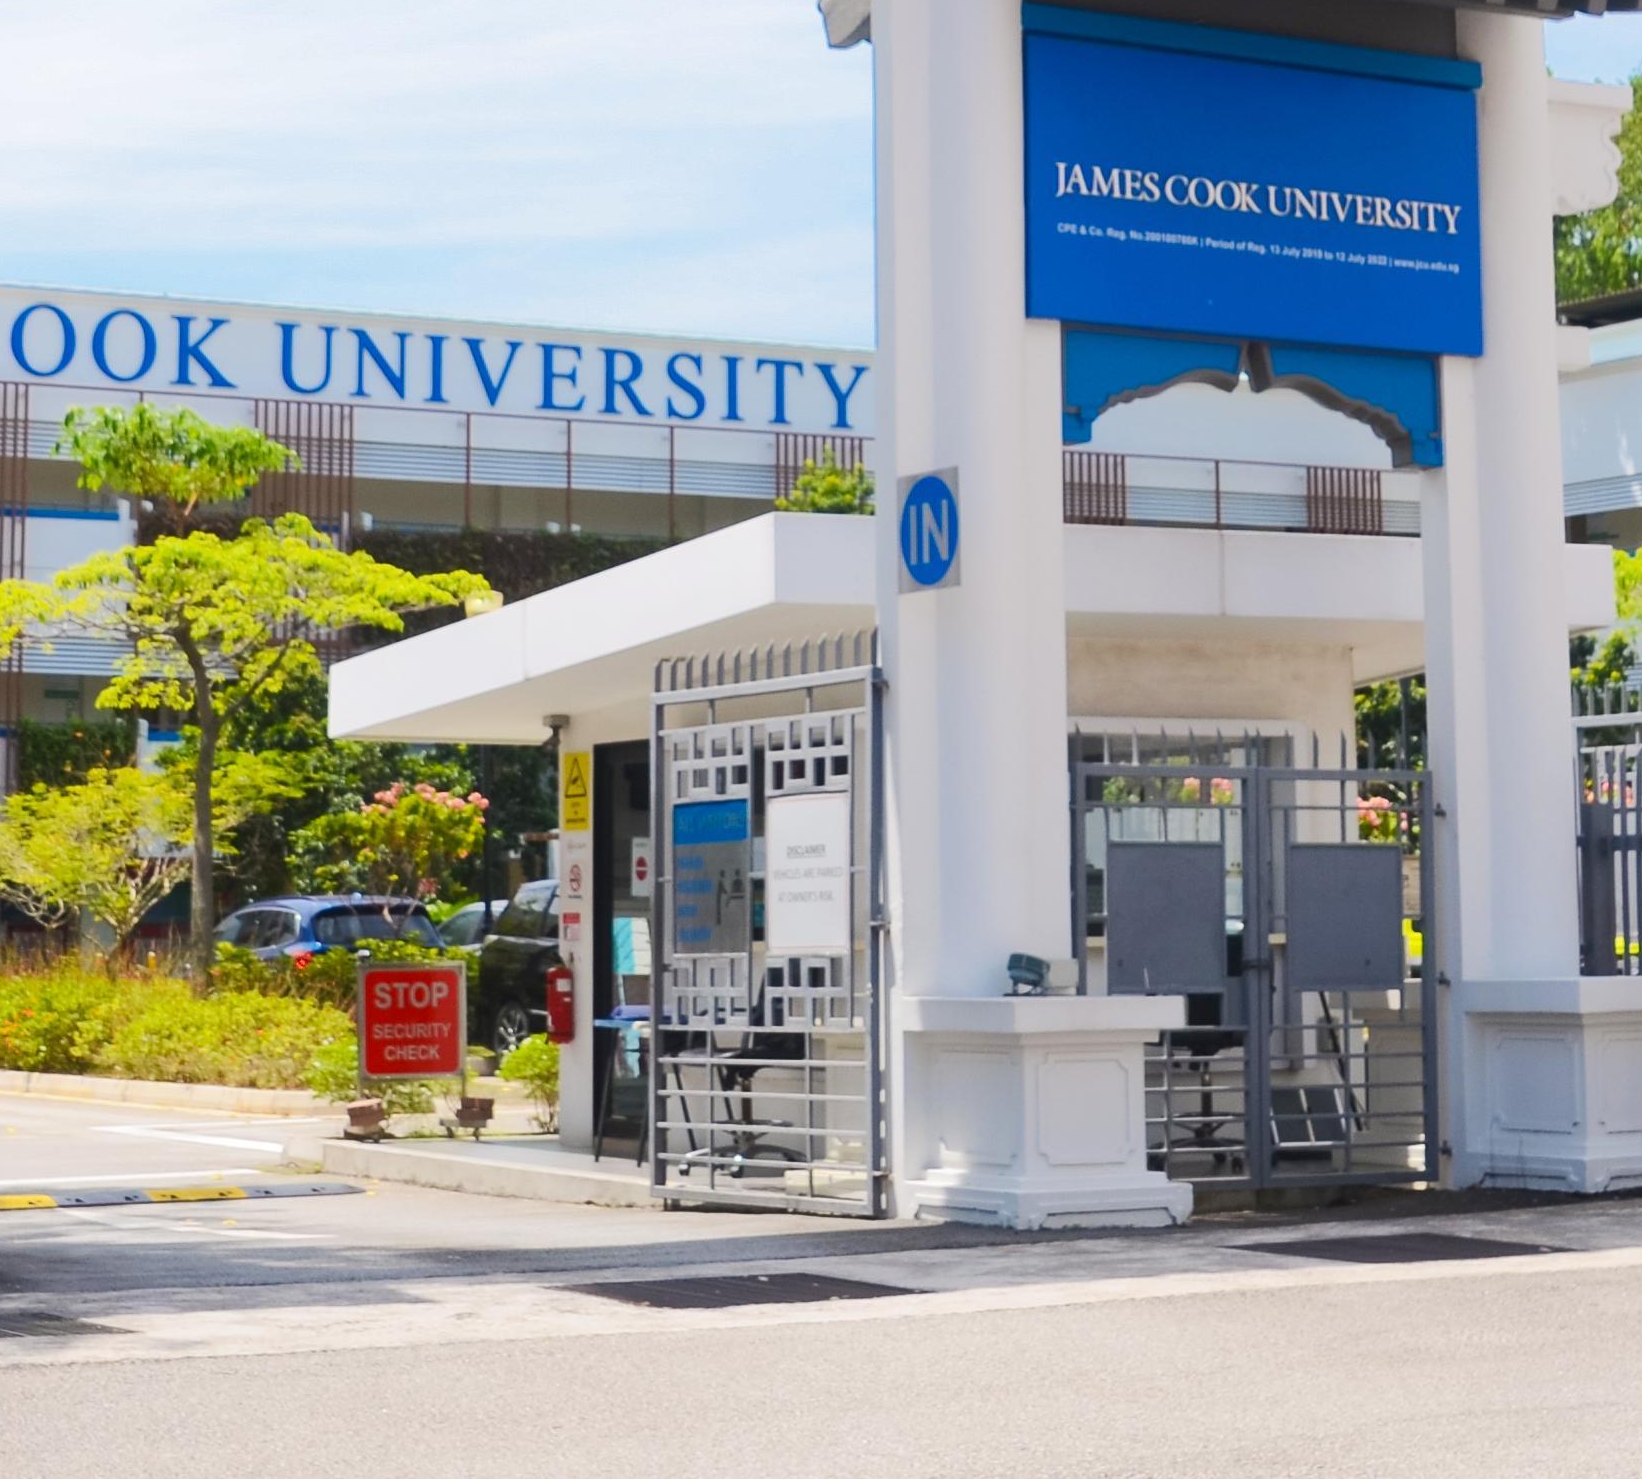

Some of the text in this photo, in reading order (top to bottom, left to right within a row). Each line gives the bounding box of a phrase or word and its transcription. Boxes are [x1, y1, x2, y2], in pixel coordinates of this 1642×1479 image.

[1055, 161, 1462, 235] JAMES COOK UNIVERSITY
[1205, 237, 1235, 250] Period
[274, 322, 870, 430] UNIVERSITY
[909, 498, 949, 566] IN
[374, 981, 449, 1010] STOP
[372, 1022, 452, 1040] SECURITY
[384, 1044, 441, 1062] CHECK
